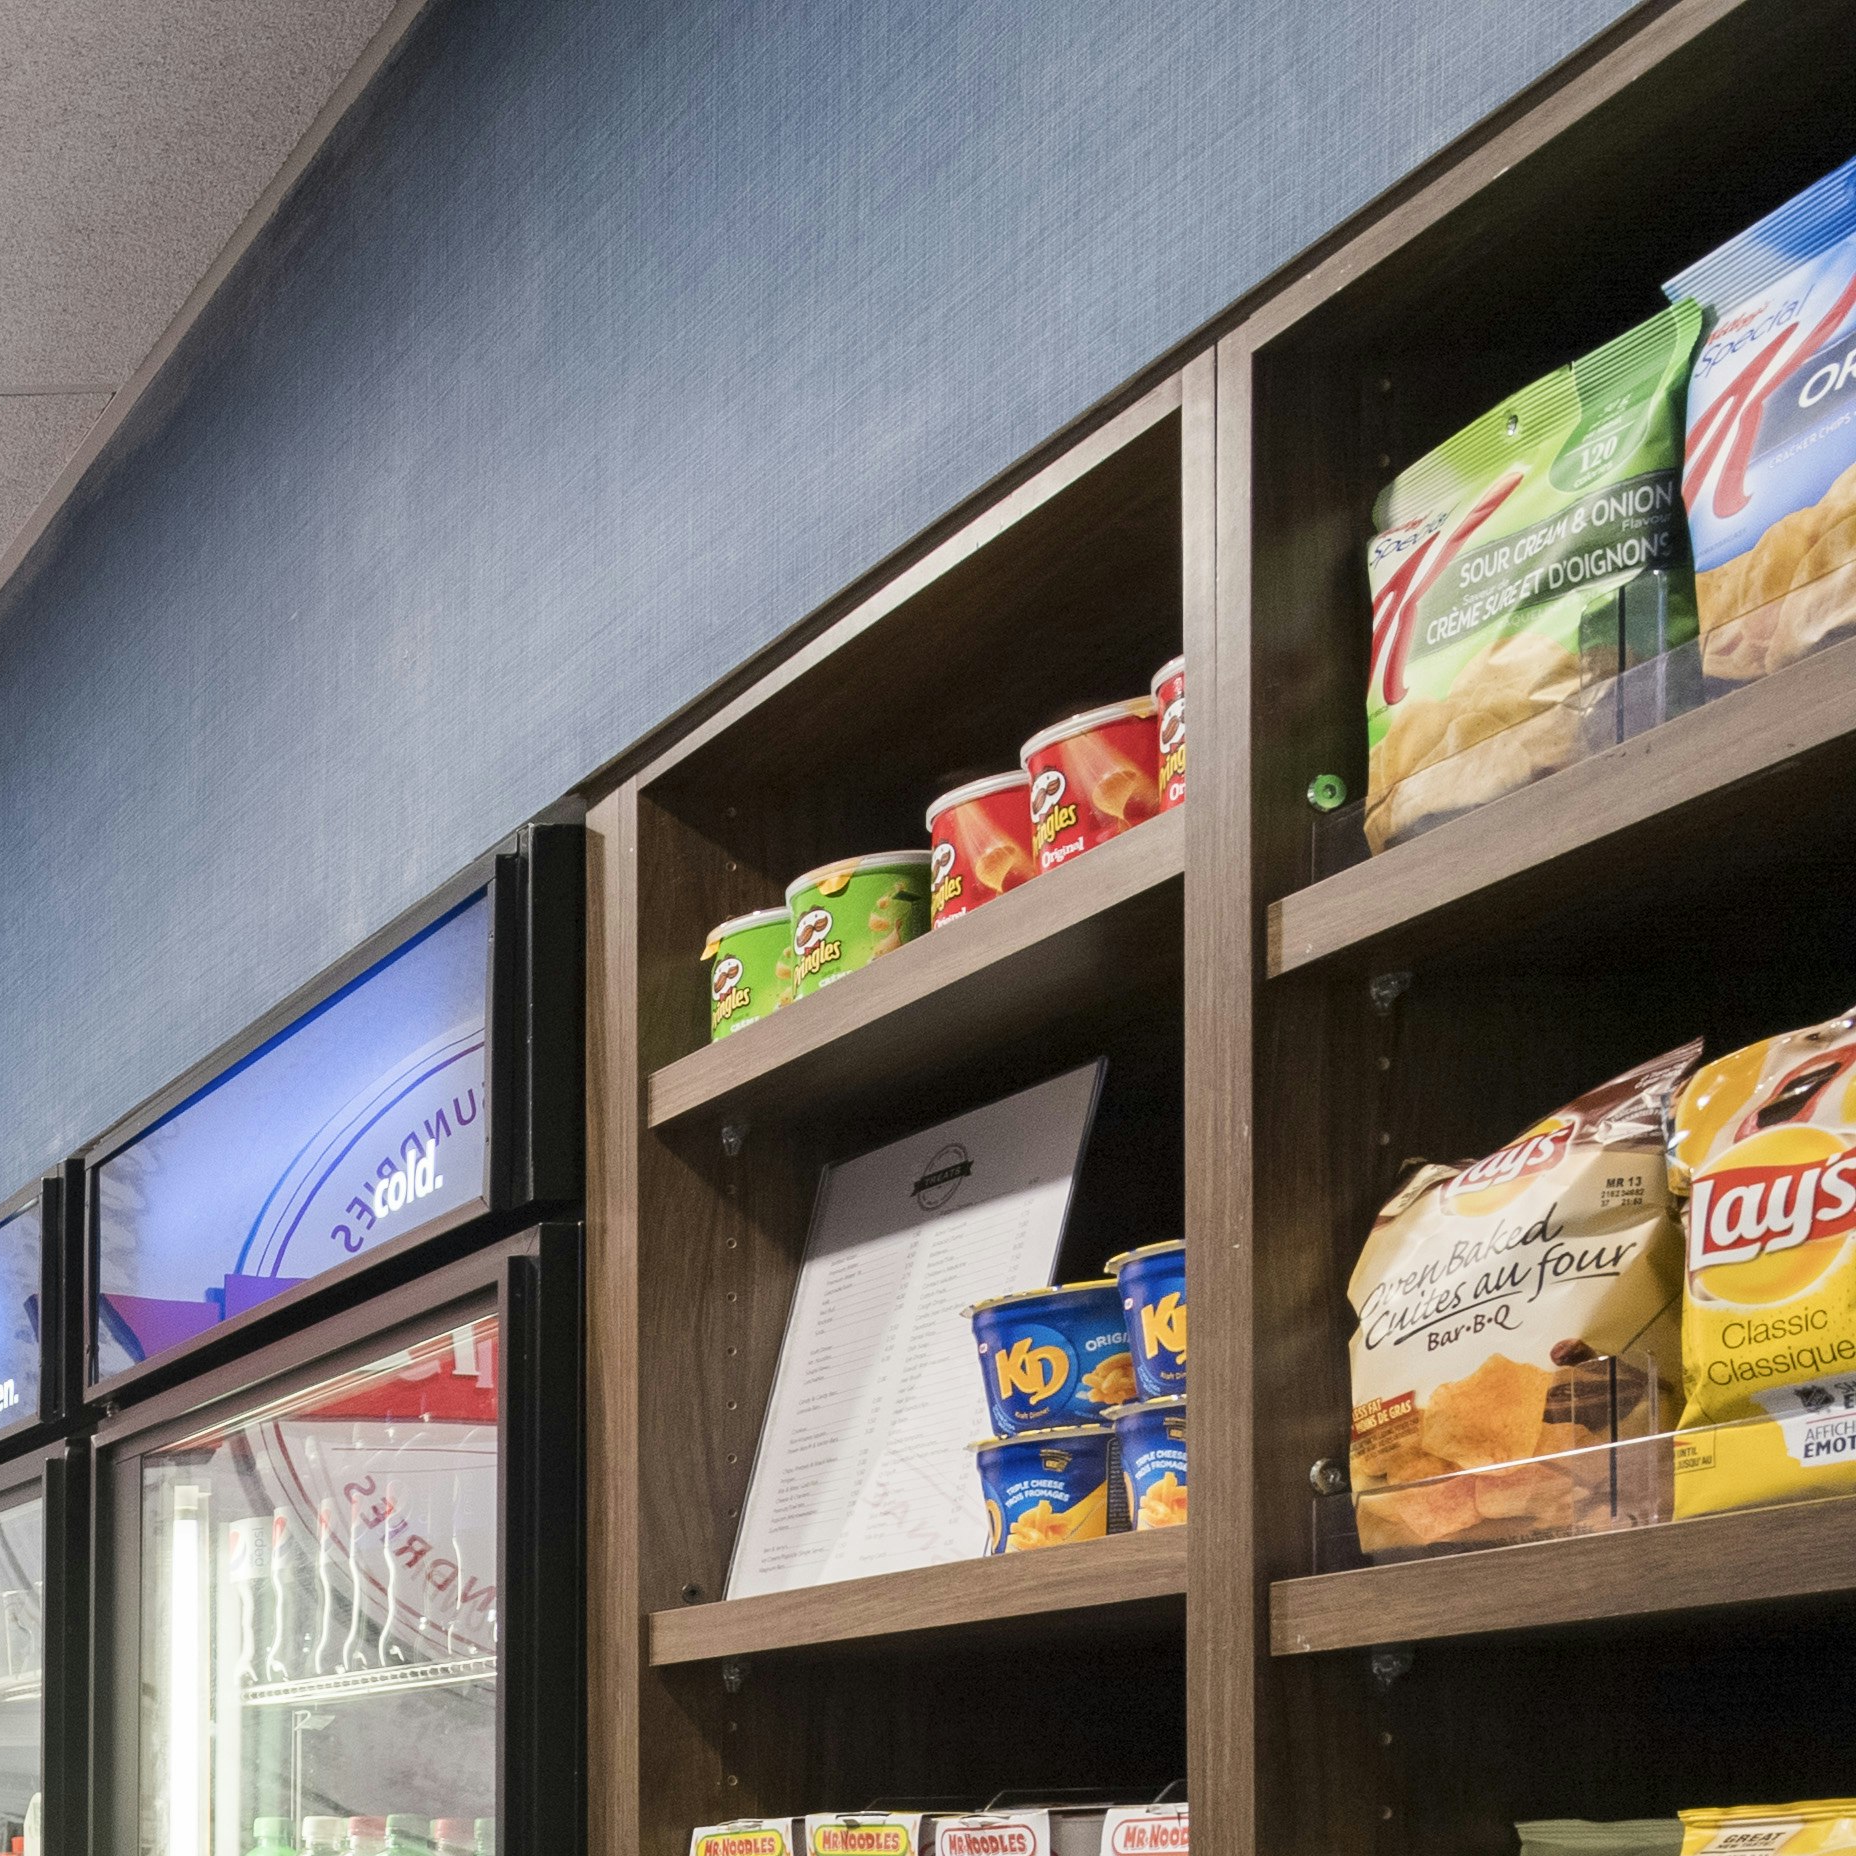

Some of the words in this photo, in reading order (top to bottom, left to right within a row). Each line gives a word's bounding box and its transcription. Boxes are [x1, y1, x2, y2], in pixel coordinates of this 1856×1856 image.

[1580, 437, 1618, 473] 120
[1459, 546, 1510, 589] SOUR
[1513, 521, 1569, 564] CREAM
[1572, 508, 1587, 535] &
[1590, 481, 1674, 526] ONION
[1427, 603, 1481, 645] CRÈME
[1519, 567, 1546, 601] ET
[1041, 836, 1084, 869] Original
[374, 1138, 443, 1218] cold.
[1444, 1122, 1571, 1198] Lay's
[1606, 1177, 1628, 1191] MR
[1629, 1176, 1643, 1189] 13
[1690, 1153, 1856, 1273] Lay's
[1358, 1253, 1449, 1324] Oven
[1452, 1201, 1563, 1277] Baked
[1364, 1283, 1465, 1352] Cuites
[1472, 1262, 1532, 1302] au
[1528, 1240, 1637, 1302] four
[1721, 1305, 1829, 1351] Classic
[995, 1337, 1069, 1405] KD
[1706, 1339, 1855, 1388] Classique
[1368, 1398, 1381, 1414] FAT
[1376, 1409, 1386, 1424] DE
[1388, 1401, 1413, 1418] GRAS
[1005, 1494, 1024, 1508] TROIS
[1024, 1489, 1070, 1502] FROMAGES
[1007, 1481, 1029, 1495] TRIPLE
[1031, 1479, 1065, 1490] CHEESE
[841, 1831, 900, 1851] NOODLES
[965, 1833, 1027, 1855] NOODLES
[1723, 1831, 1785, 1845] GREAT
